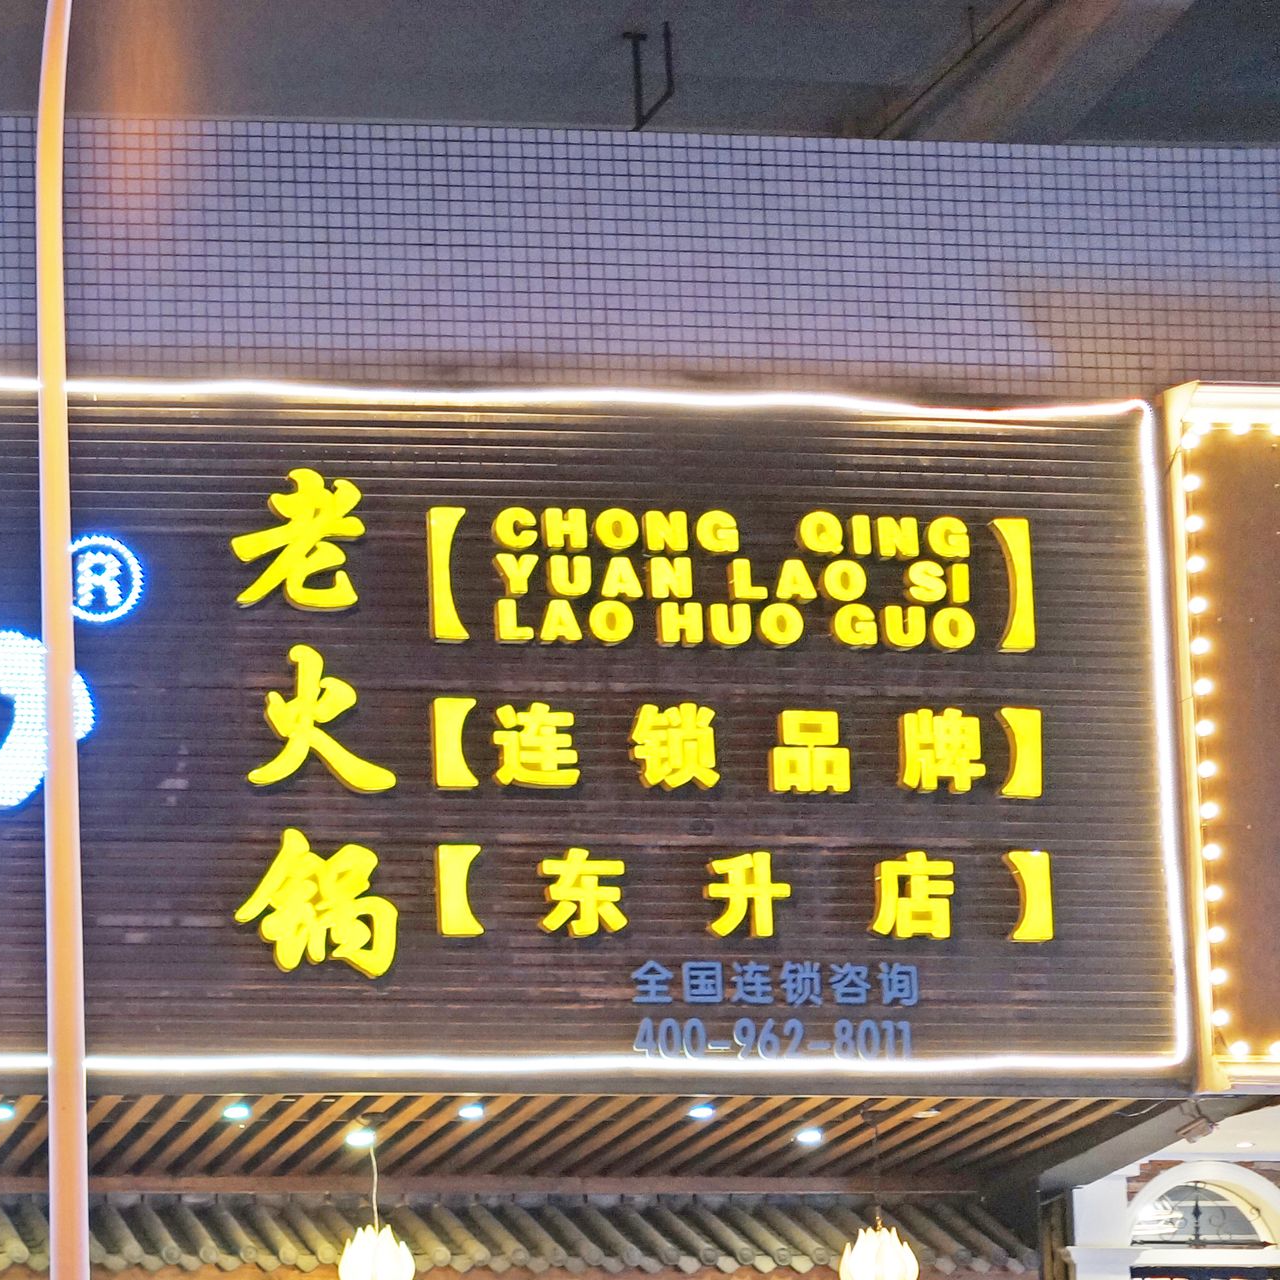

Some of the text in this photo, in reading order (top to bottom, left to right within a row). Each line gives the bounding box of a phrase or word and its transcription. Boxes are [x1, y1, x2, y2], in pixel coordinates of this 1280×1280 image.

[493, 507, 970, 558] CHONG QING
[496, 554, 970, 603] YUAN LAO SI
[495, 599, 976, 651] LAO HUO GUO
[231, 468, 398, 978] 老火锅
[631, 960, 919, 1007] 全国连锁咨询
[632, 1017, 913, 1061] 400-962-8011
